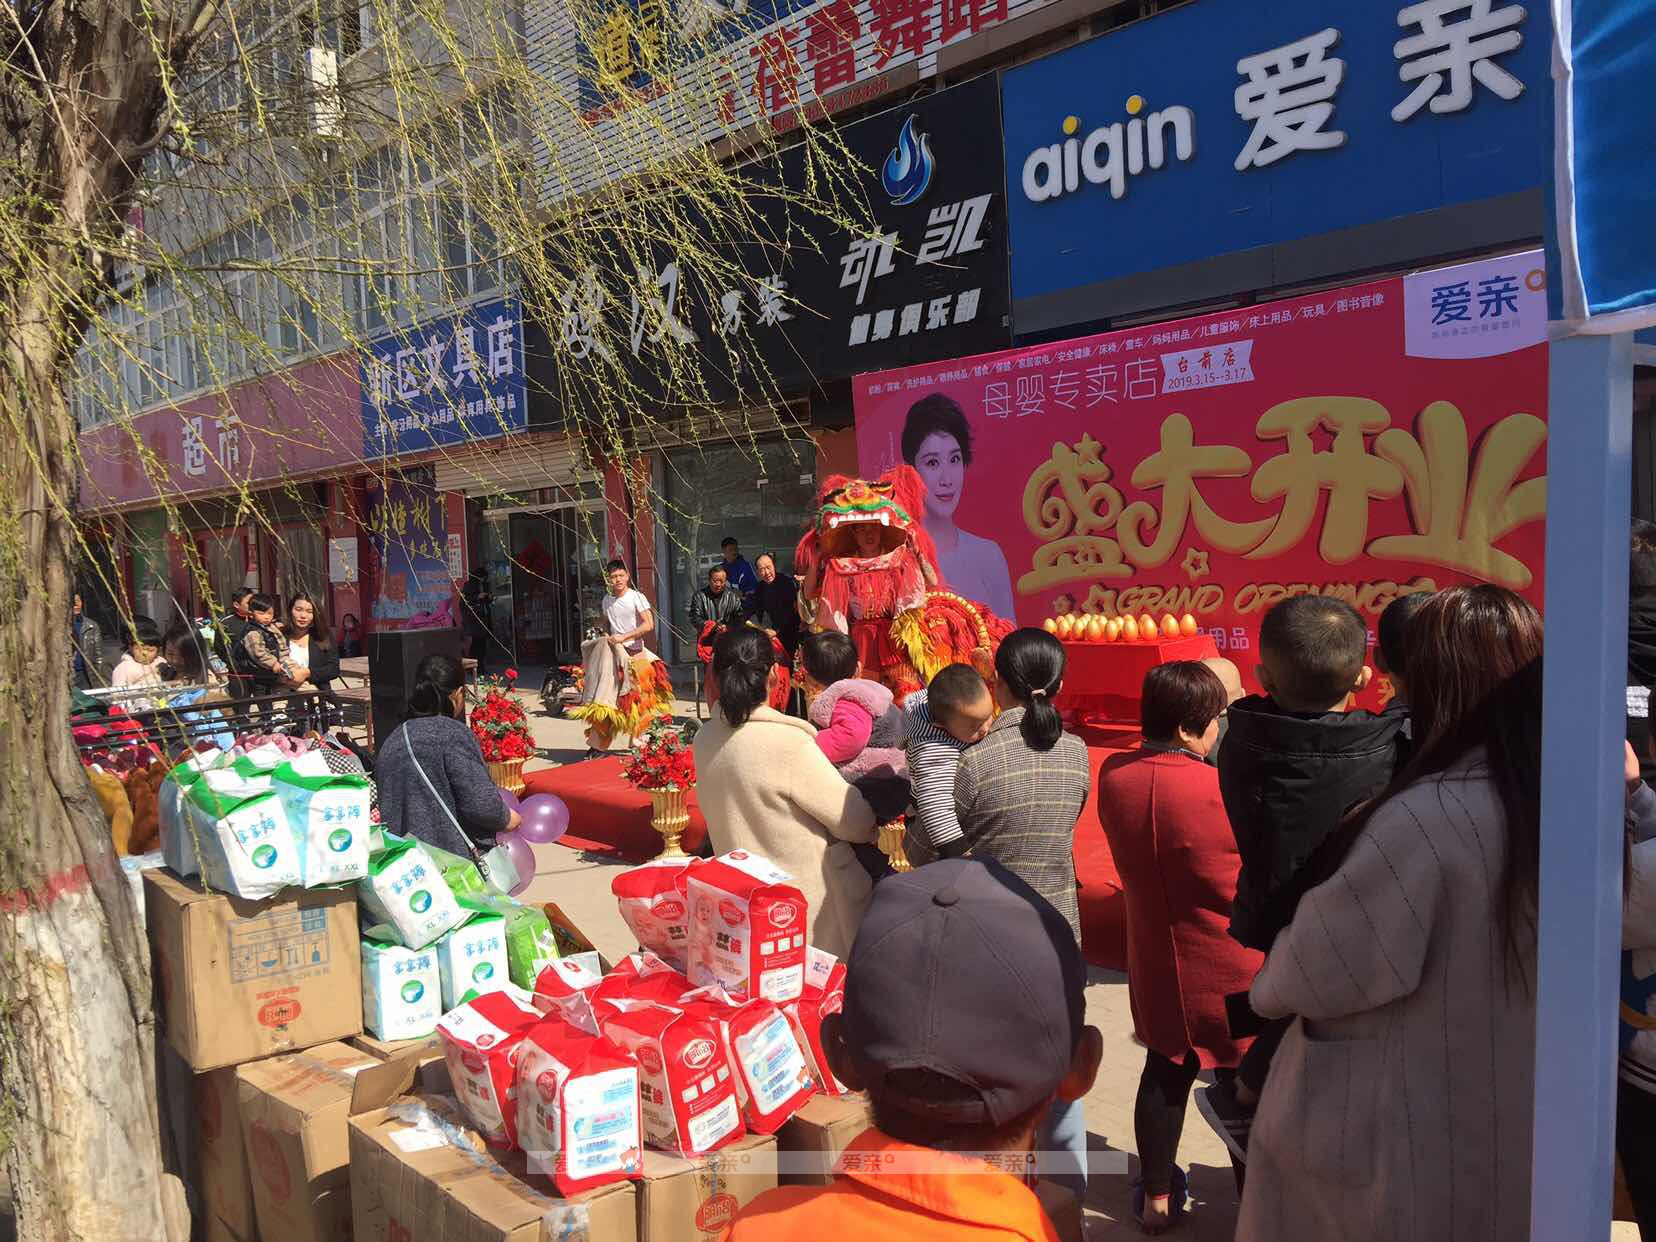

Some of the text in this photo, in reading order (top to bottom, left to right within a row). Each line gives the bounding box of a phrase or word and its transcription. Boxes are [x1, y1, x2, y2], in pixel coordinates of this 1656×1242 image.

[1021, 95, 1194, 201] aiqin
[1233, 0, 1527, 171] 爱亲
[848, 287, 982, 346] 健身俱乐部
[1431, 275, 1519, 326] 爱亲
[369, 316, 514, 405] 新区文具店
[983, 358, 1158, 419] 母婴专卖店
[182, 415, 241, 476] 超市
[1017, 395, 1547, 592] 盛大开业
[1117, 583, 1225, 614] GRAND
